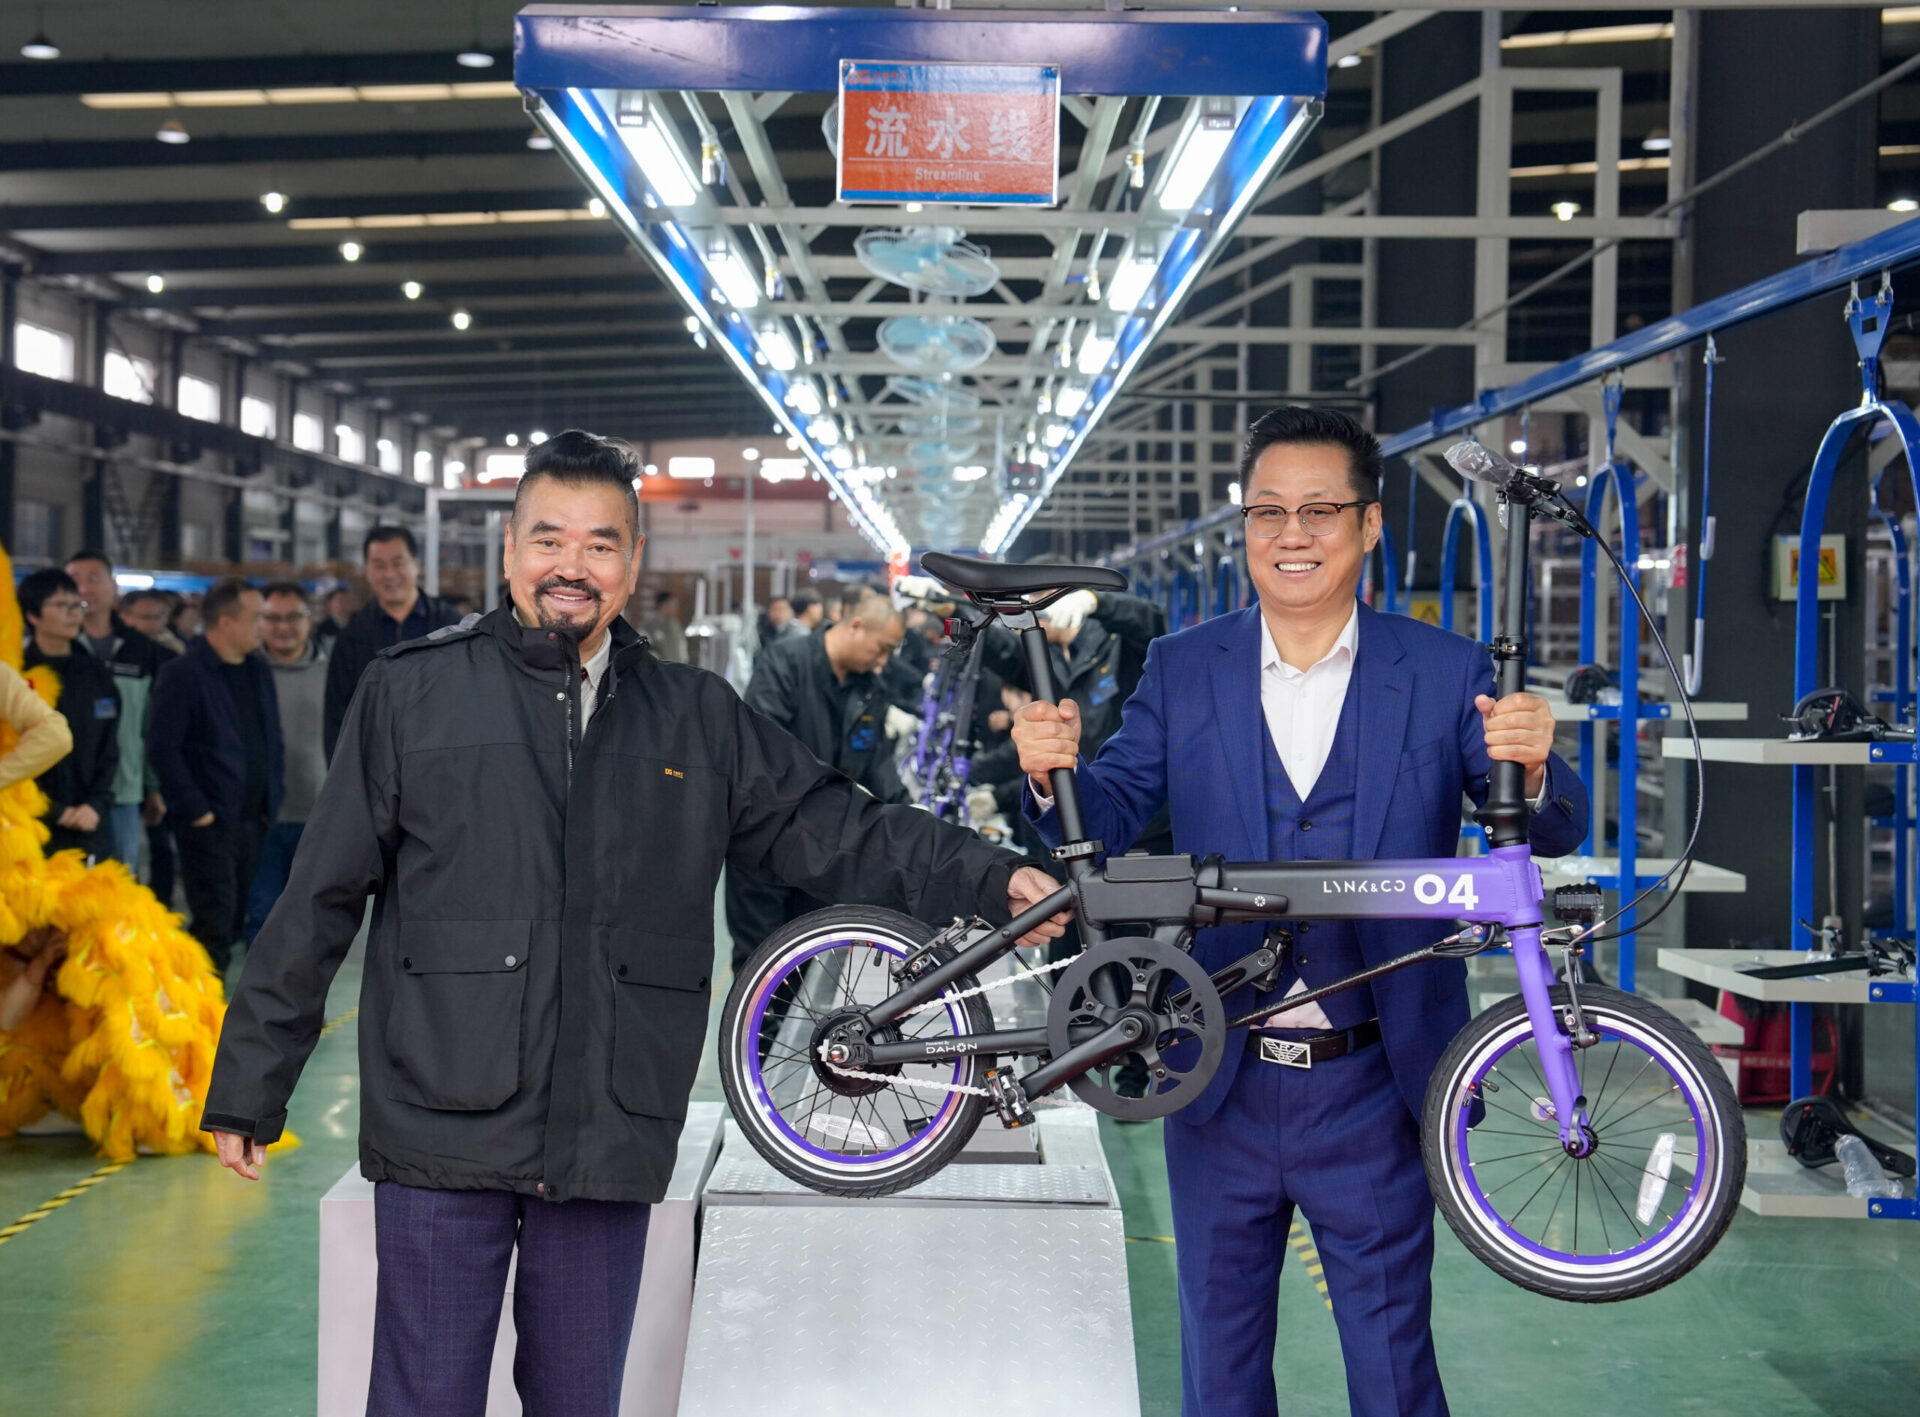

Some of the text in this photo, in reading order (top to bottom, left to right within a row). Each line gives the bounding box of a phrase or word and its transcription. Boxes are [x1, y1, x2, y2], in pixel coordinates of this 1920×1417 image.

[865, 106, 1033, 159] 流水线
[915, 167, 981, 182] Streamline
[1413, 873, 1479, 911] 04
[925, 1042, 978, 1054] DAHON
